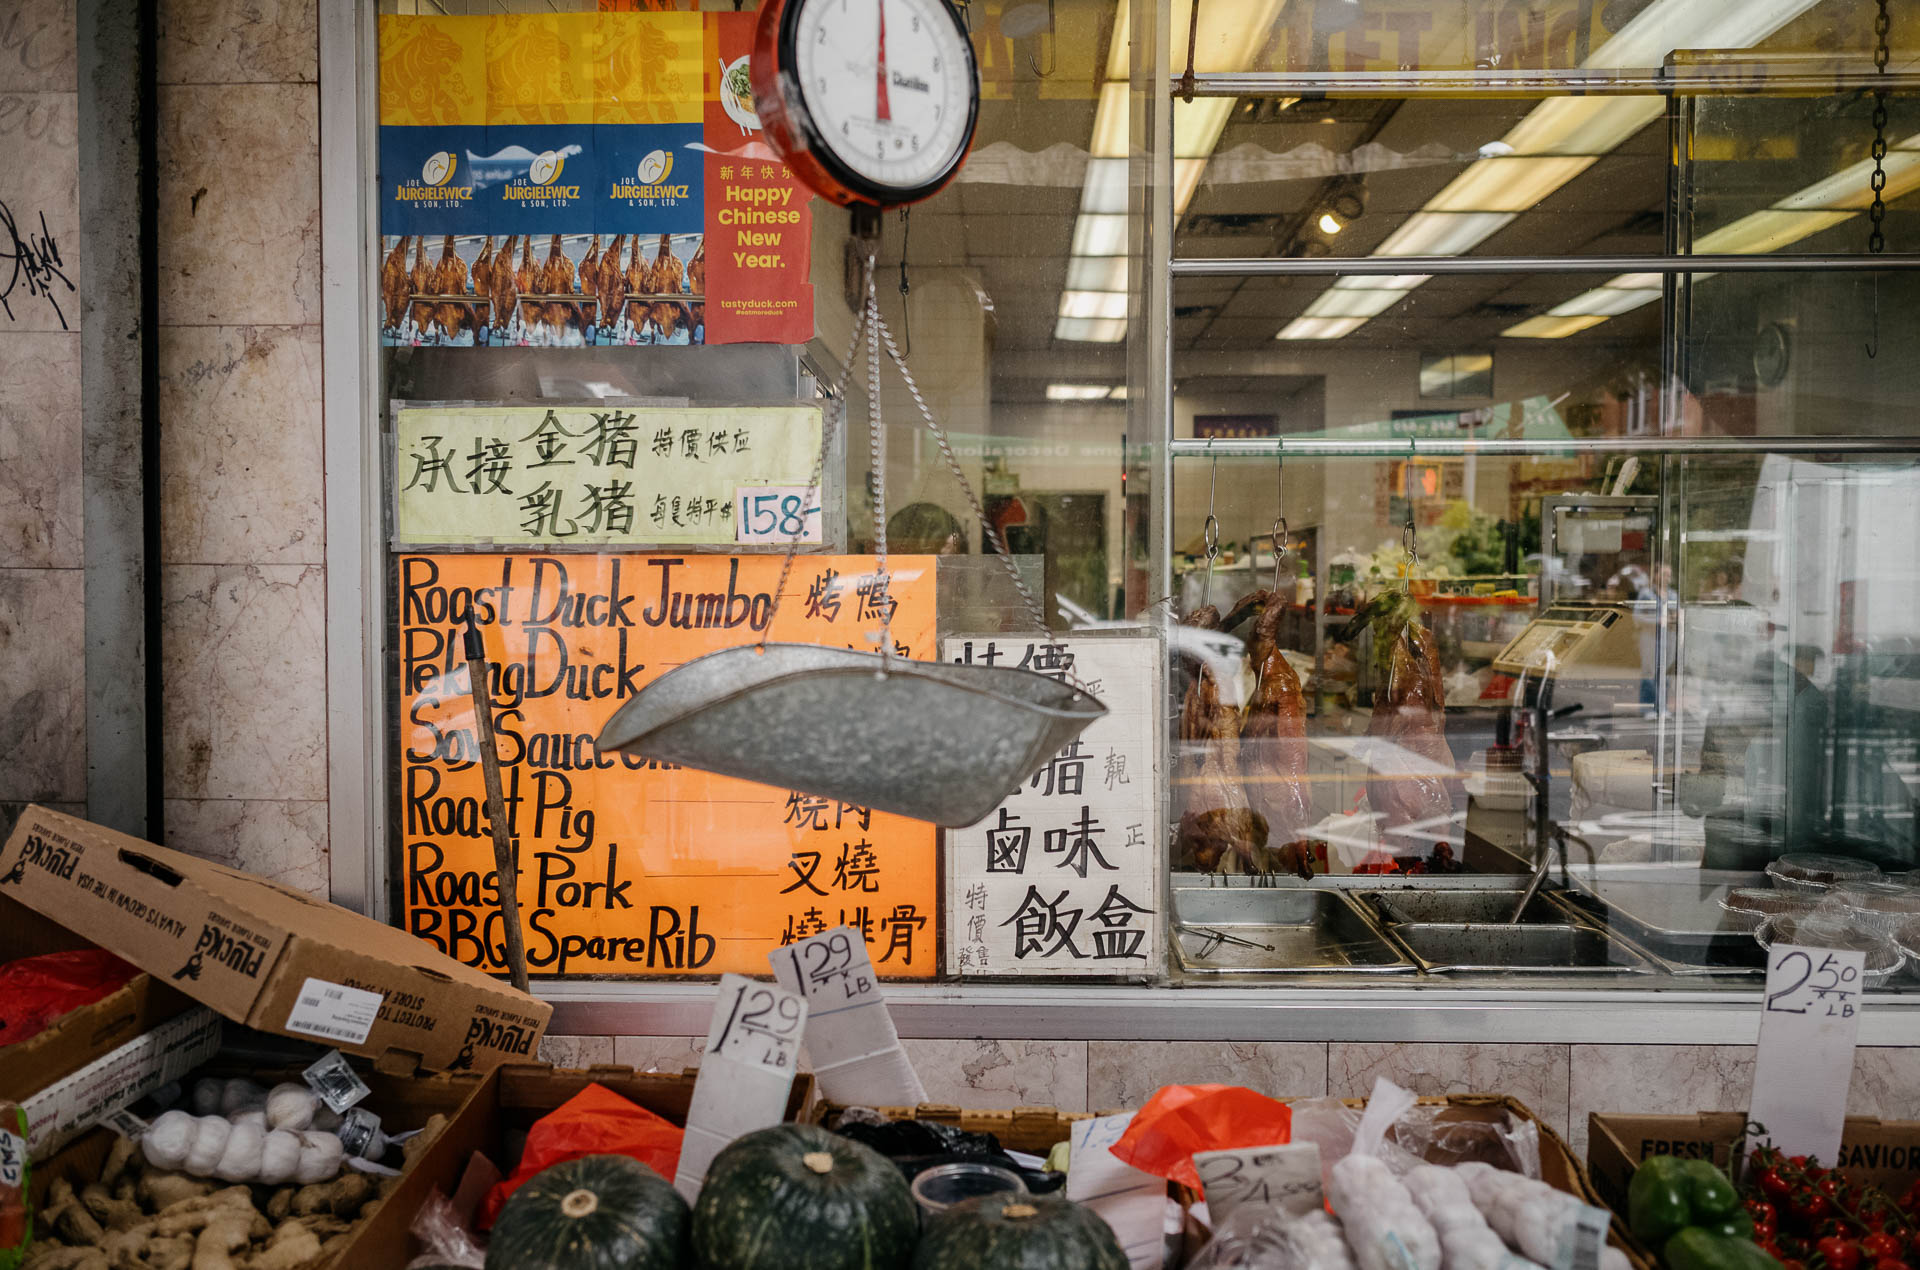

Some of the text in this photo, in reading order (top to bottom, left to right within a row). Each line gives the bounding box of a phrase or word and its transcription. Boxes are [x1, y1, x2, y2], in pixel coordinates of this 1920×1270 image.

[395, 184, 473, 200] JURGIELEWICZ
[406, 179, 420, 187] JOE
[502, 184, 580, 200] JURGIELEWICZ
[513, 178, 527, 187] JOE
[609, 183, 689, 199] JURGIELEWICZ
[621, 177, 635, 186] JOE
[720, 164, 796, 181] 新年快乐
[718, 207, 801, 225] Chinese
[726, 185, 793, 207] Happy
[737, 230, 781, 247] New
[733, 252, 786, 268] Year.
[721, 299, 798, 310] tastyduck.com
[402, 435, 513, 496] 承接
[517, 479, 635, 537] 乳猪
[402, 557, 773, 631] Roast Duck Jumbo
[804, 567, 898, 627] 烤鴨
[403, 627, 645, 709] Pekng Duck
[407, 765, 595, 853] Roast Pig
[408, 840, 633, 909] Roast Pork
[779, 838, 880, 897] 叉燒
[76, 872, 187, 938] ALWAYS GROWN IN THE USA
[998, 884, 1157, 959] 飯盒
[526, 908, 645, 975] Spare
[647, 905, 715, 969] Rib
[790, 933, 872, 999] 1.29 LB
[1767, 951, 1857, 1018] 2.50 LB
[395, 991, 426, 1010] STORE
[395, 1011, 437, 1032] PROTECT
[710, 984, 800, 1067] 1.29 LB
